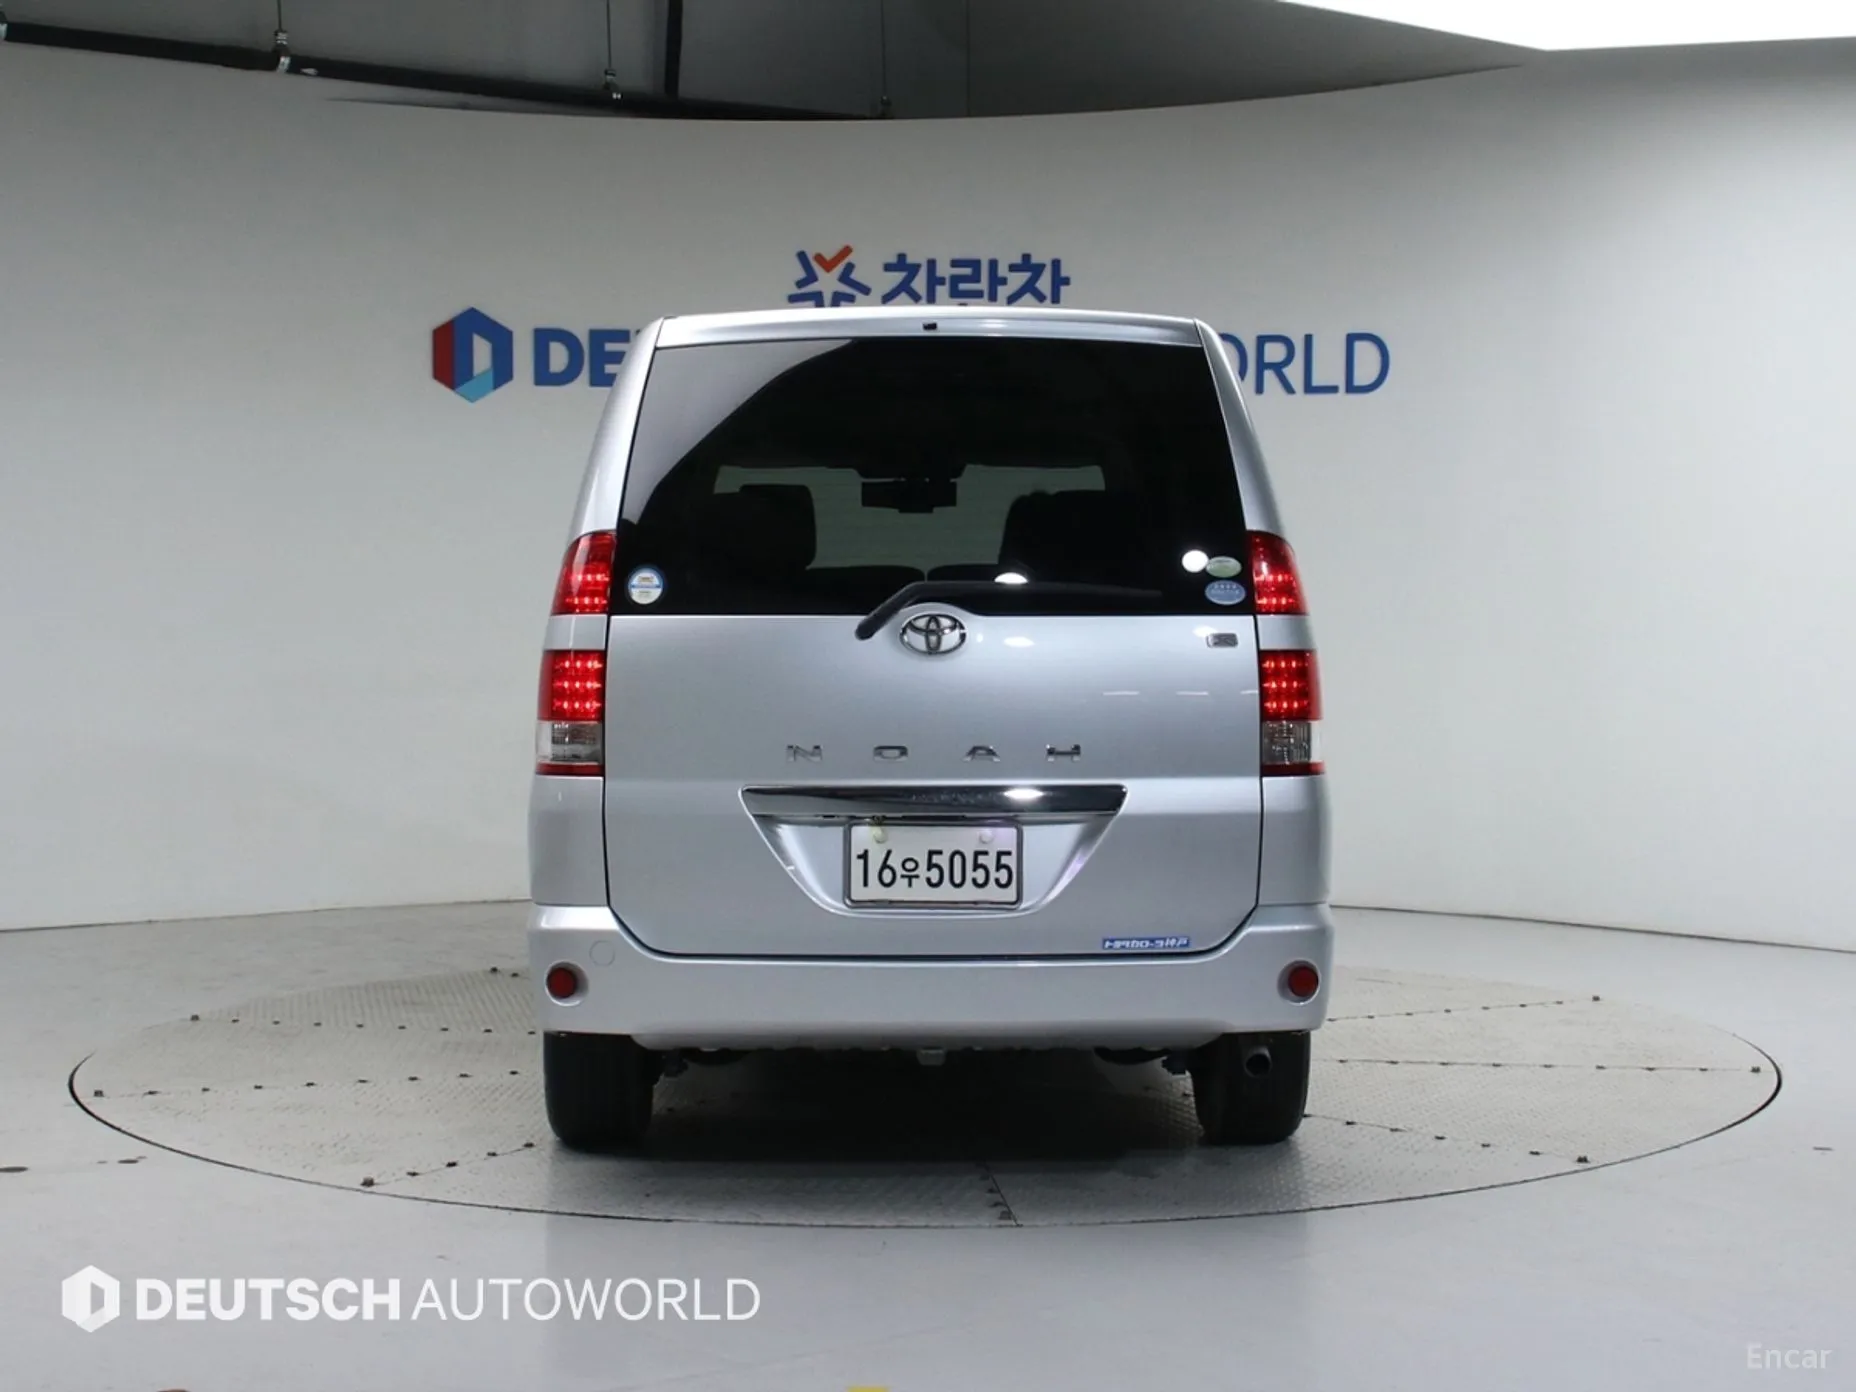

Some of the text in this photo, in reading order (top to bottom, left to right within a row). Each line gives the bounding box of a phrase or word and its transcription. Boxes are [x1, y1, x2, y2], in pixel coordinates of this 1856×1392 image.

[533, 327, 641, 387] DE
[786, 744, 1081, 762] NOAH
[856, 849, 1014, 889] 16우5055
